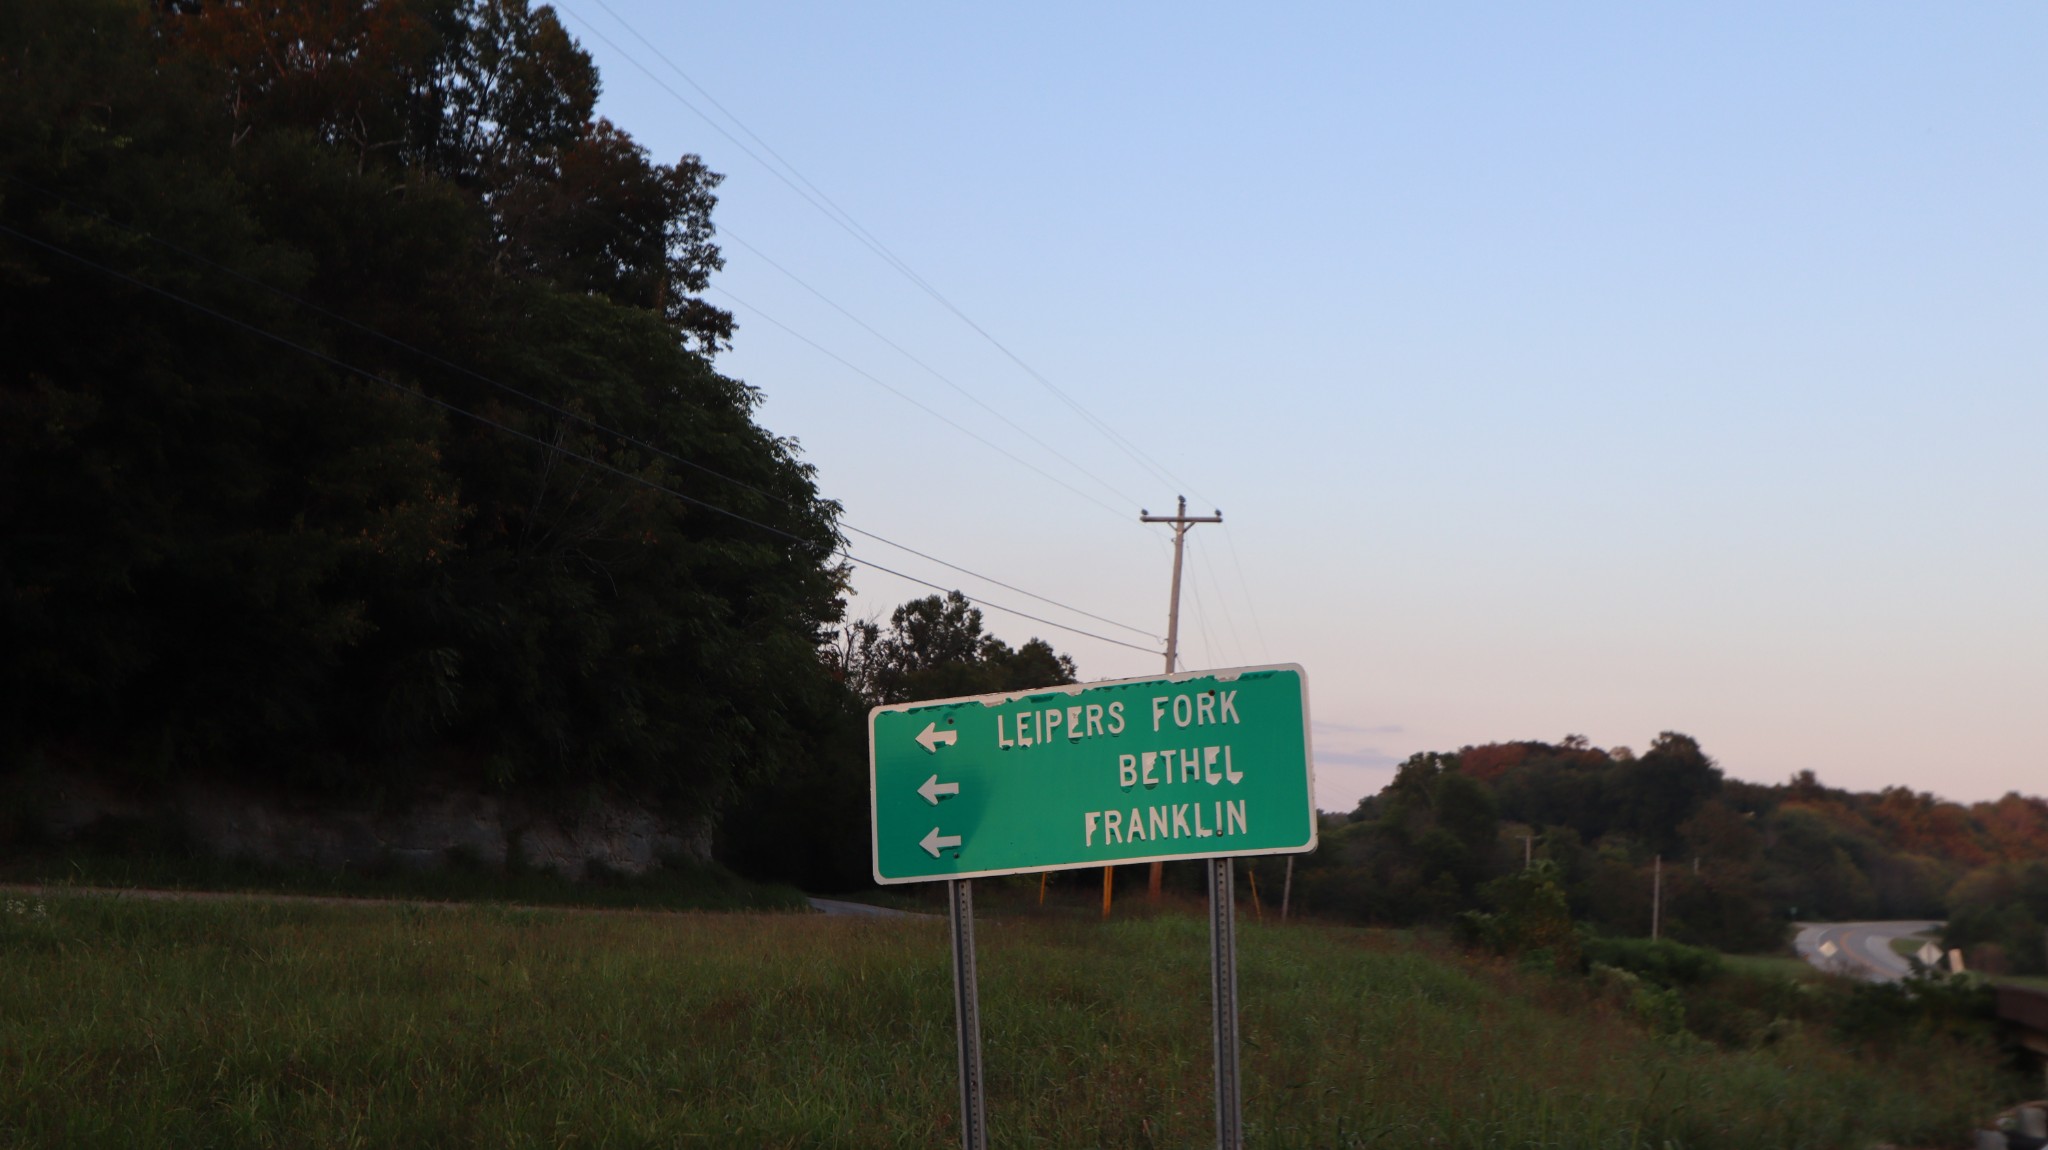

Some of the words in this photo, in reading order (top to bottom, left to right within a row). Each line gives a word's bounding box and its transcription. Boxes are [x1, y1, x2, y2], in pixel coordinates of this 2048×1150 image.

[997, 701, 1125, 748] LEIPERS
[1152, 690, 1240, 732] FORK
[1119, 745, 1244, 787] BETHEL
[1084, 799, 1247, 847] FRANKLIN
